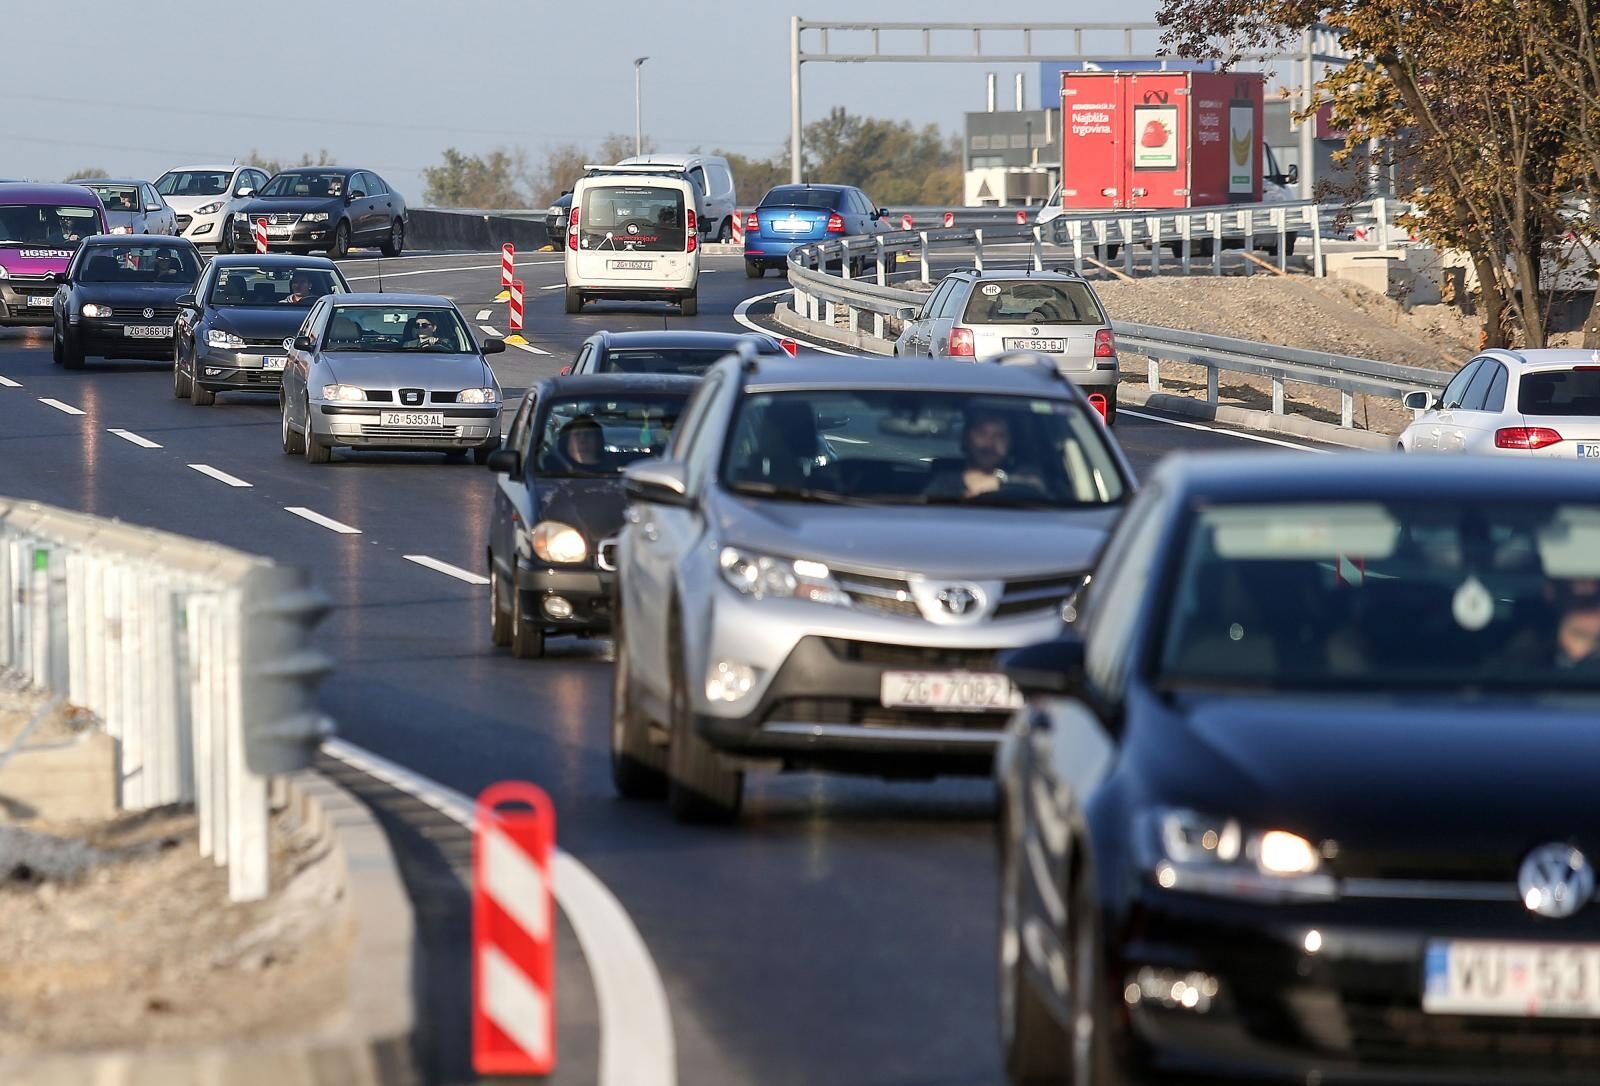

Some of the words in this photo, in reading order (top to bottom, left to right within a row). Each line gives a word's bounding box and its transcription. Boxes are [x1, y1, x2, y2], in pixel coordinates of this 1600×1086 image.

[985, 286, 997, 294] HR
[33, 297, 42, 305] ZG
[129, 327, 140, 336] ZG
[145, 327, 172, 336] 366-UF
[1013, 341, 1025, 350] NG
[269, 358, 280, 368] SK
[387, 414, 400, 425] ZG
[406, 414, 441, 425] 5353-AL
[1585, 445, 1600, 458] ZG
